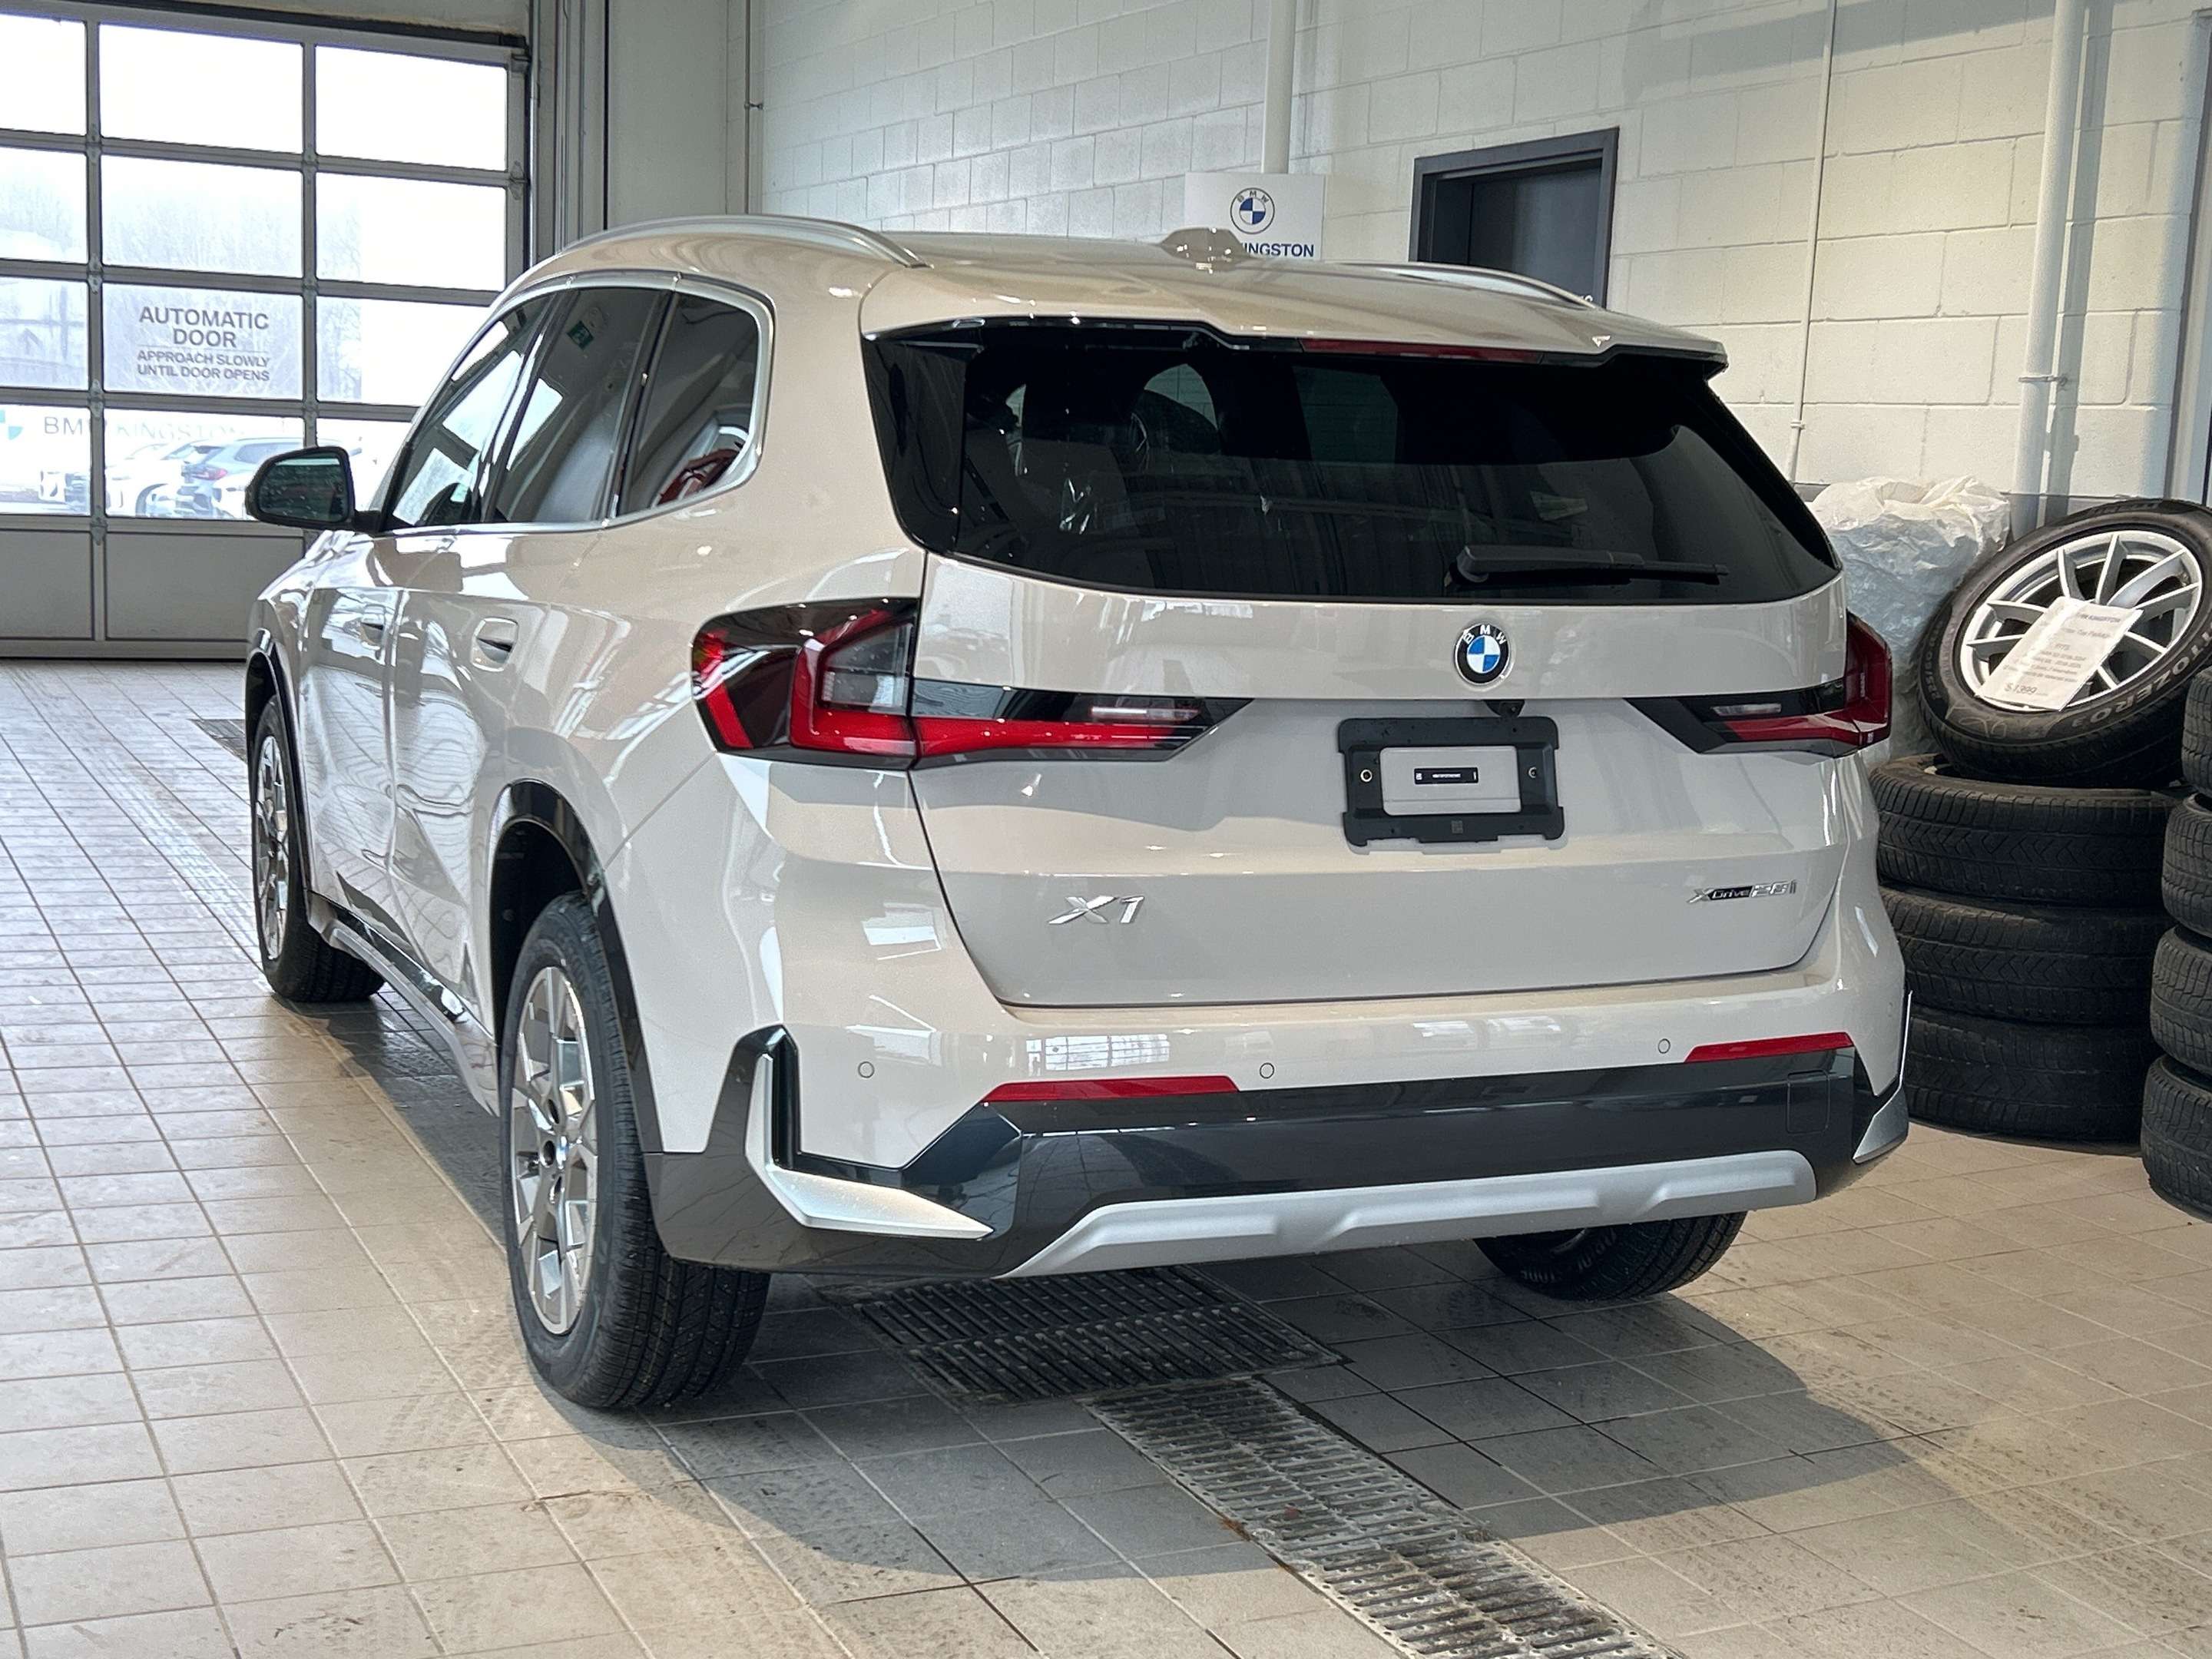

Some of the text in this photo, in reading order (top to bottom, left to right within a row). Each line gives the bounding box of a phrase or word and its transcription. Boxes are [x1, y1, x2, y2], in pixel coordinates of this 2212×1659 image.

[1237, 190, 1270, 204] BMW
[1242, 242, 1315, 257] INGSTON
[139, 306, 270, 330] AUTOMATIC
[172, 328, 237, 348] DOOR
[137, 350, 270, 367] APPROACH SLOWLY
[137, 364, 270, 381] UNTIL DOOR OPENS
[1462, 624, 1507, 645] BMW
[1047, 895, 1146, 925] X1
